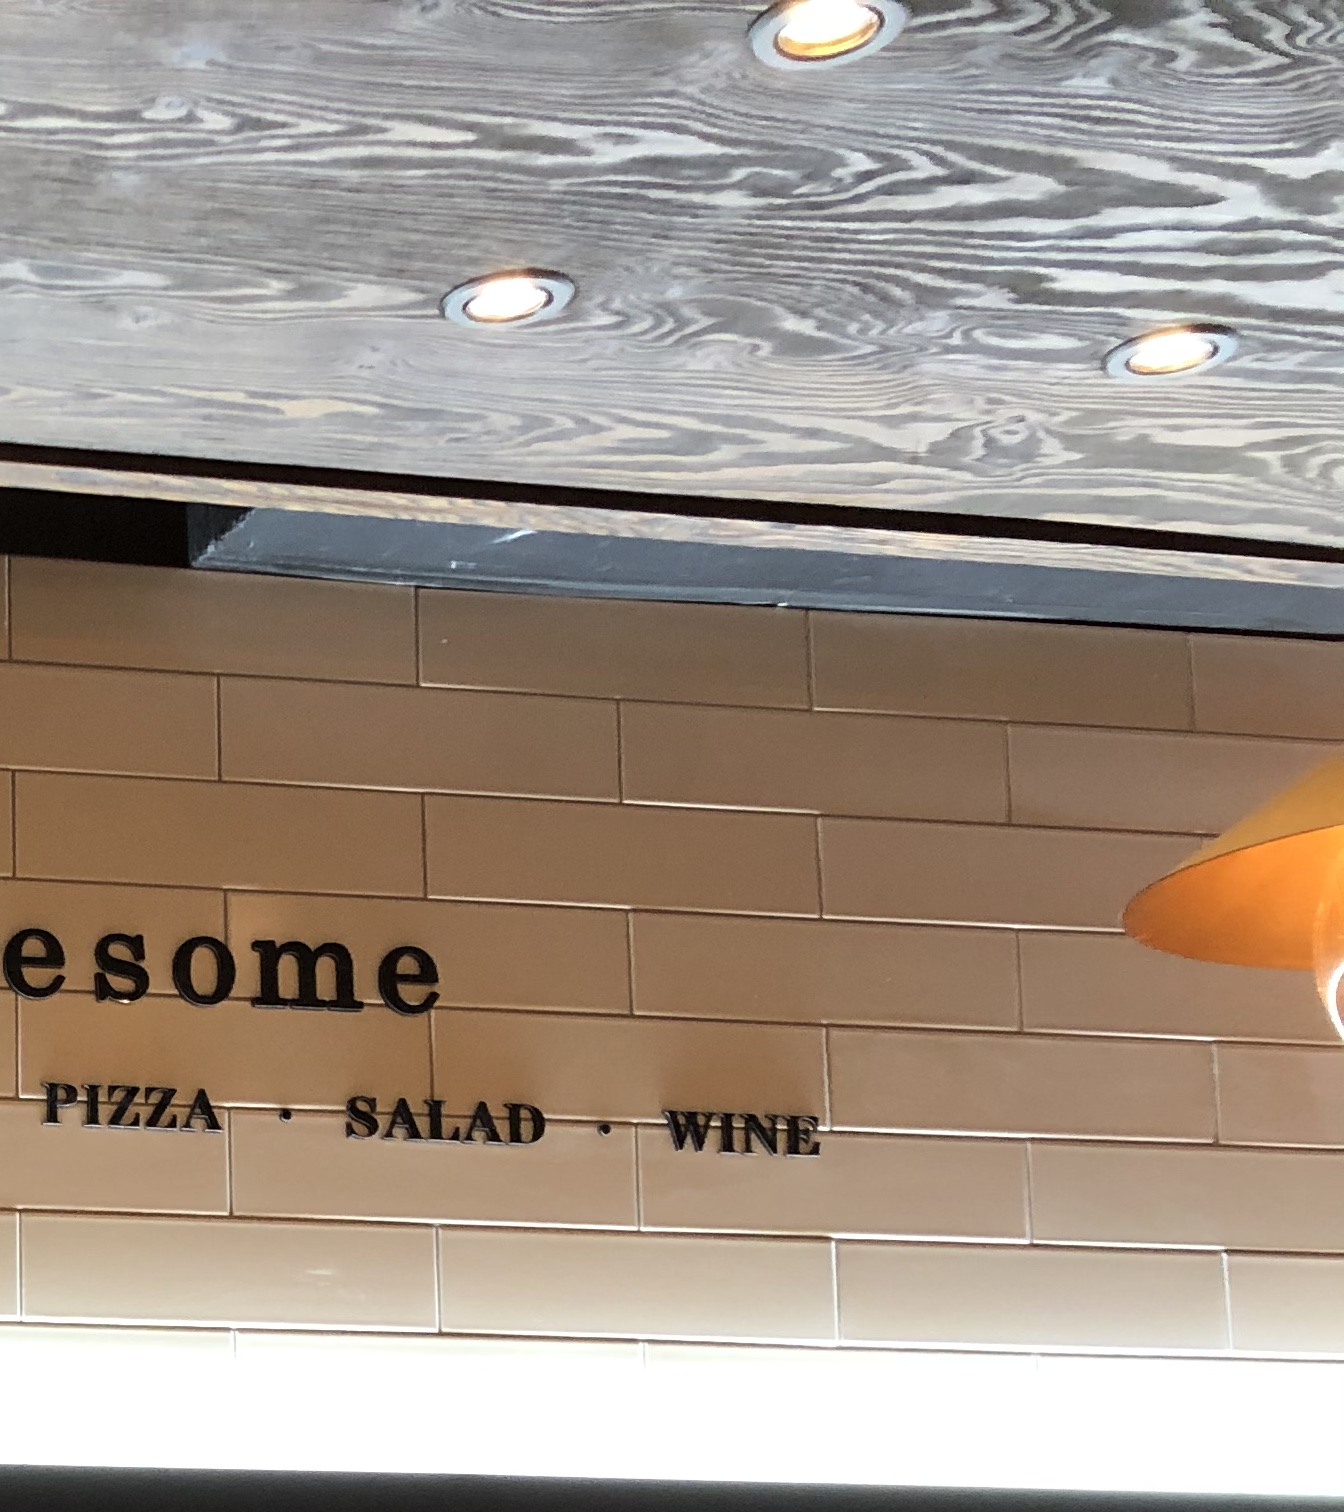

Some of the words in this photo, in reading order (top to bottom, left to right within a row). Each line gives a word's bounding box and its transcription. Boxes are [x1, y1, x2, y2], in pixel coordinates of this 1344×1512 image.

[41, 1082, 223, 1133] PIZZA
[345, 1095, 547, 1147] SALAD
[661, 1109, 821, 1158] WINE
